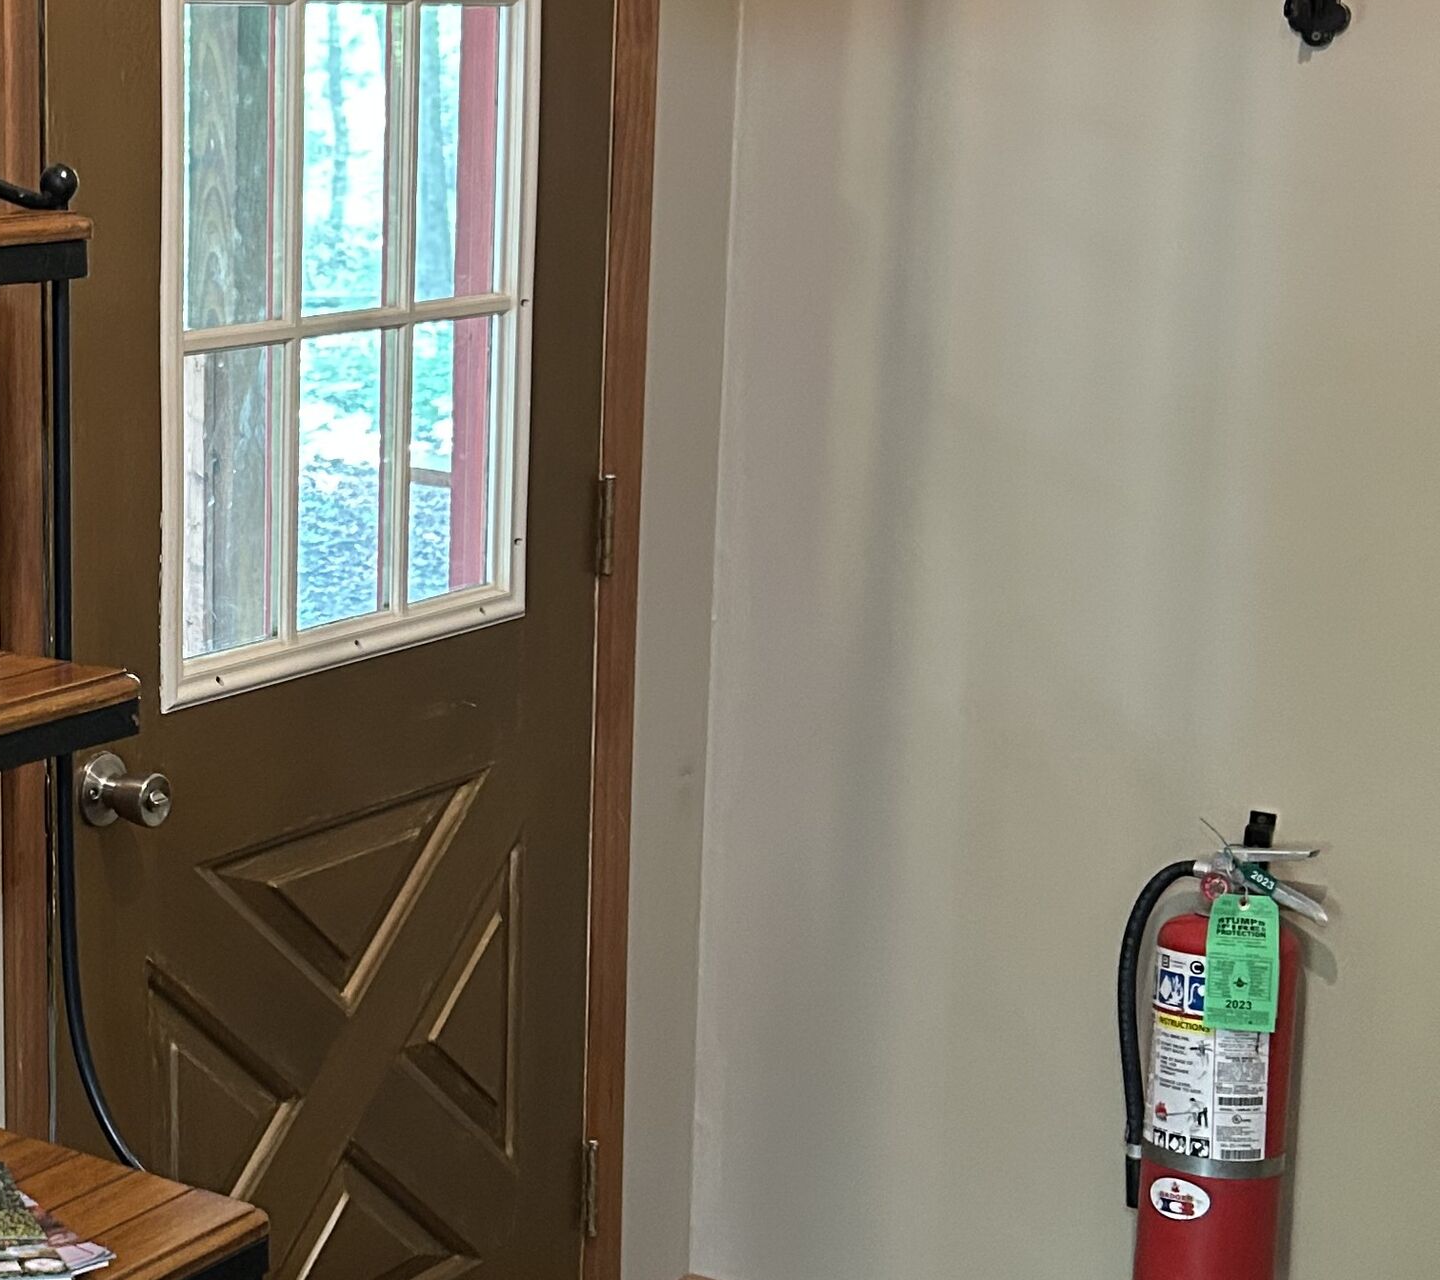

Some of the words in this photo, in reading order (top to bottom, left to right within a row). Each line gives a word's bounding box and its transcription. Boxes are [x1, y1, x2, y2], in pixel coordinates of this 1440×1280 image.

[1250, 870, 1275, 890] 2023
[1216, 929, 1266, 939] PROTECTION
[1225, 1000, 1252, 1010] 2023
